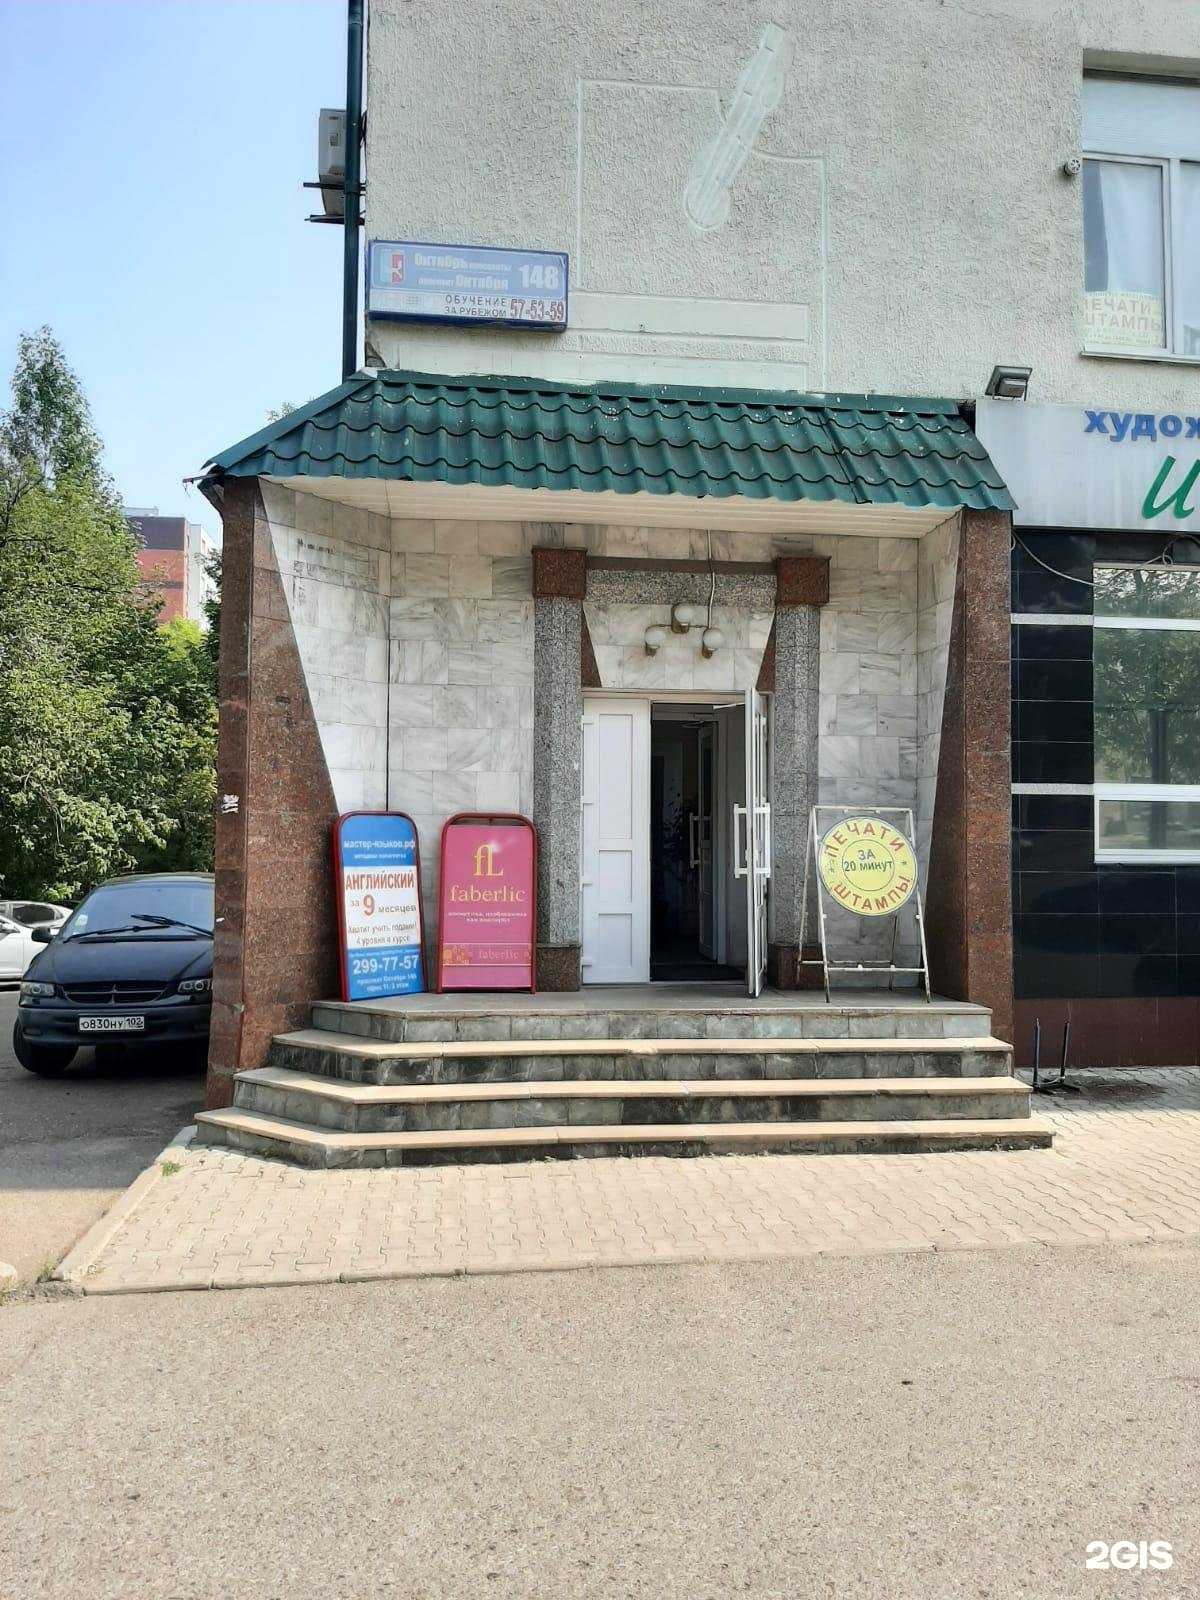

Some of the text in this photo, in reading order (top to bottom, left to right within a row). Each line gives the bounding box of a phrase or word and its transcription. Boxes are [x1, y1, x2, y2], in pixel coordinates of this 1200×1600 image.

[414, 252, 468, 270] Октябрь
[454, 273, 509, 291] Октября
[518, 264, 560, 290] 148
[445, 294, 507, 307] ОБУЧЕНИЕ
[510, 298, 565, 321] 57-53-59
[444, 305, 507, 318] ЗА РУБЕЖОМ
[824, 822, 906, 858] ПЕЧАТИ
[857, 848, 876, 861] ЗА
[843, 861, 894, 872] 20 МИНУТ
[345, 870, 415, 891] АНГЛИЙСКИЙ
[449, 884, 526, 903] faberlic
[833, 875, 911, 911] ШТАМПЫ
[363, 894, 375, 917] 9
[378, 904, 417, 914] месяцев
[478, 947, 520, 960] faberlic
[352, 954, 419, 975] 299-77-57
